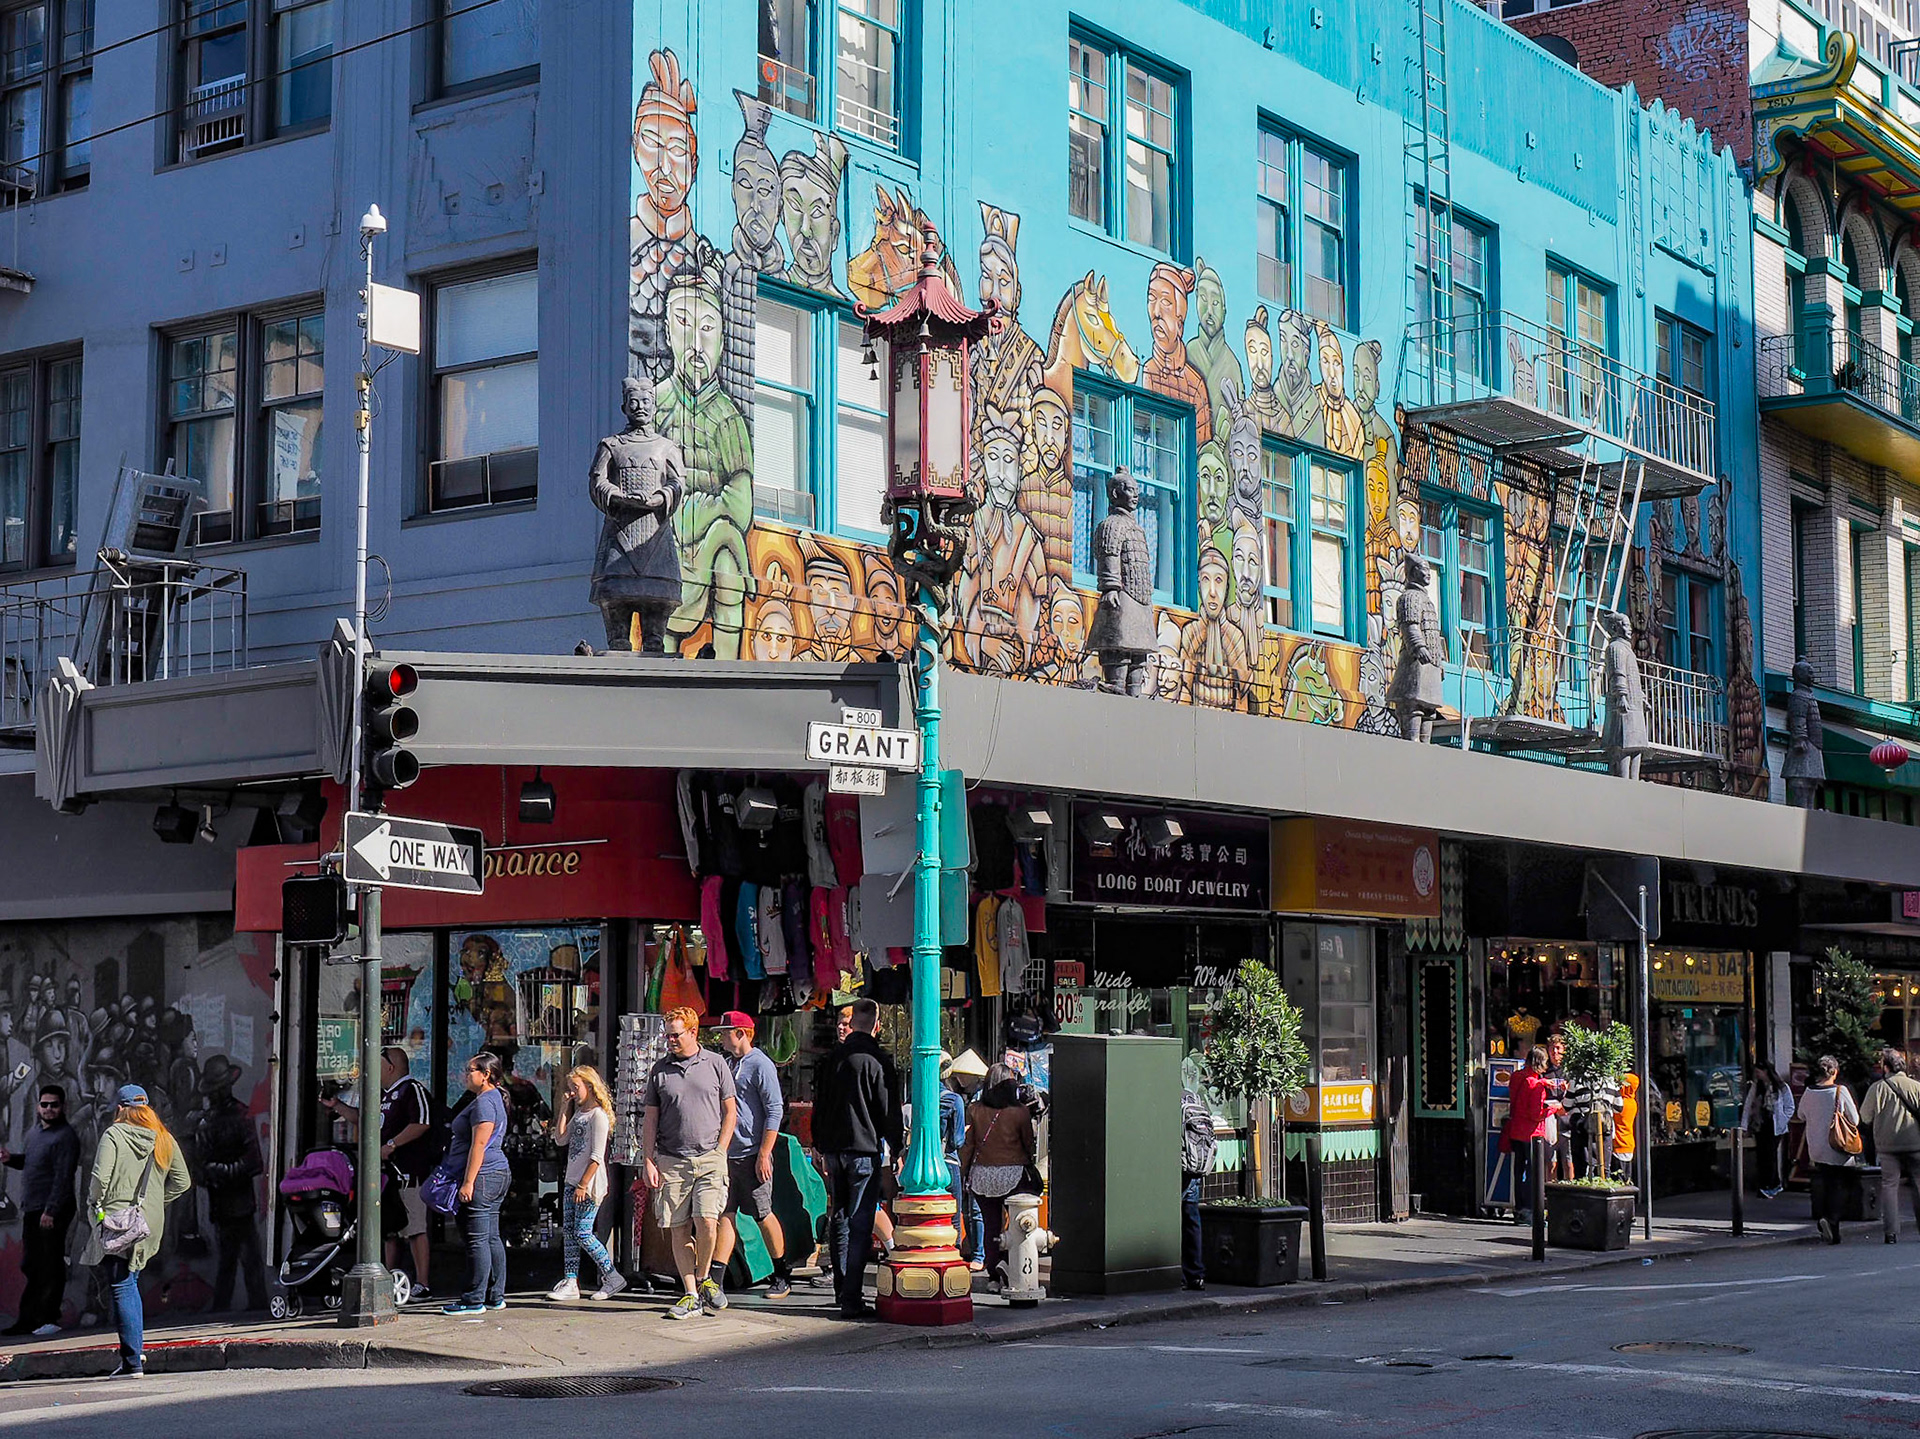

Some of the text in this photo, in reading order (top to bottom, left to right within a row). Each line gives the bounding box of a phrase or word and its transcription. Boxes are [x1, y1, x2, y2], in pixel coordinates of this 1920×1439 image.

[856, 712, 877, 725] 800
[819, 730, 909, 760] GRANT
[835, 769, 881, 787] 都板街
[390, 839, 469, 871] ONE WAY
[1097, 873, 1251, 898] LONG BOAT JEWELRY
[1668, 880, 1759, 928] TRENDS
[1058, 977, 1077, 986] SALE
[1194, 965, 1217, 987] 70%
